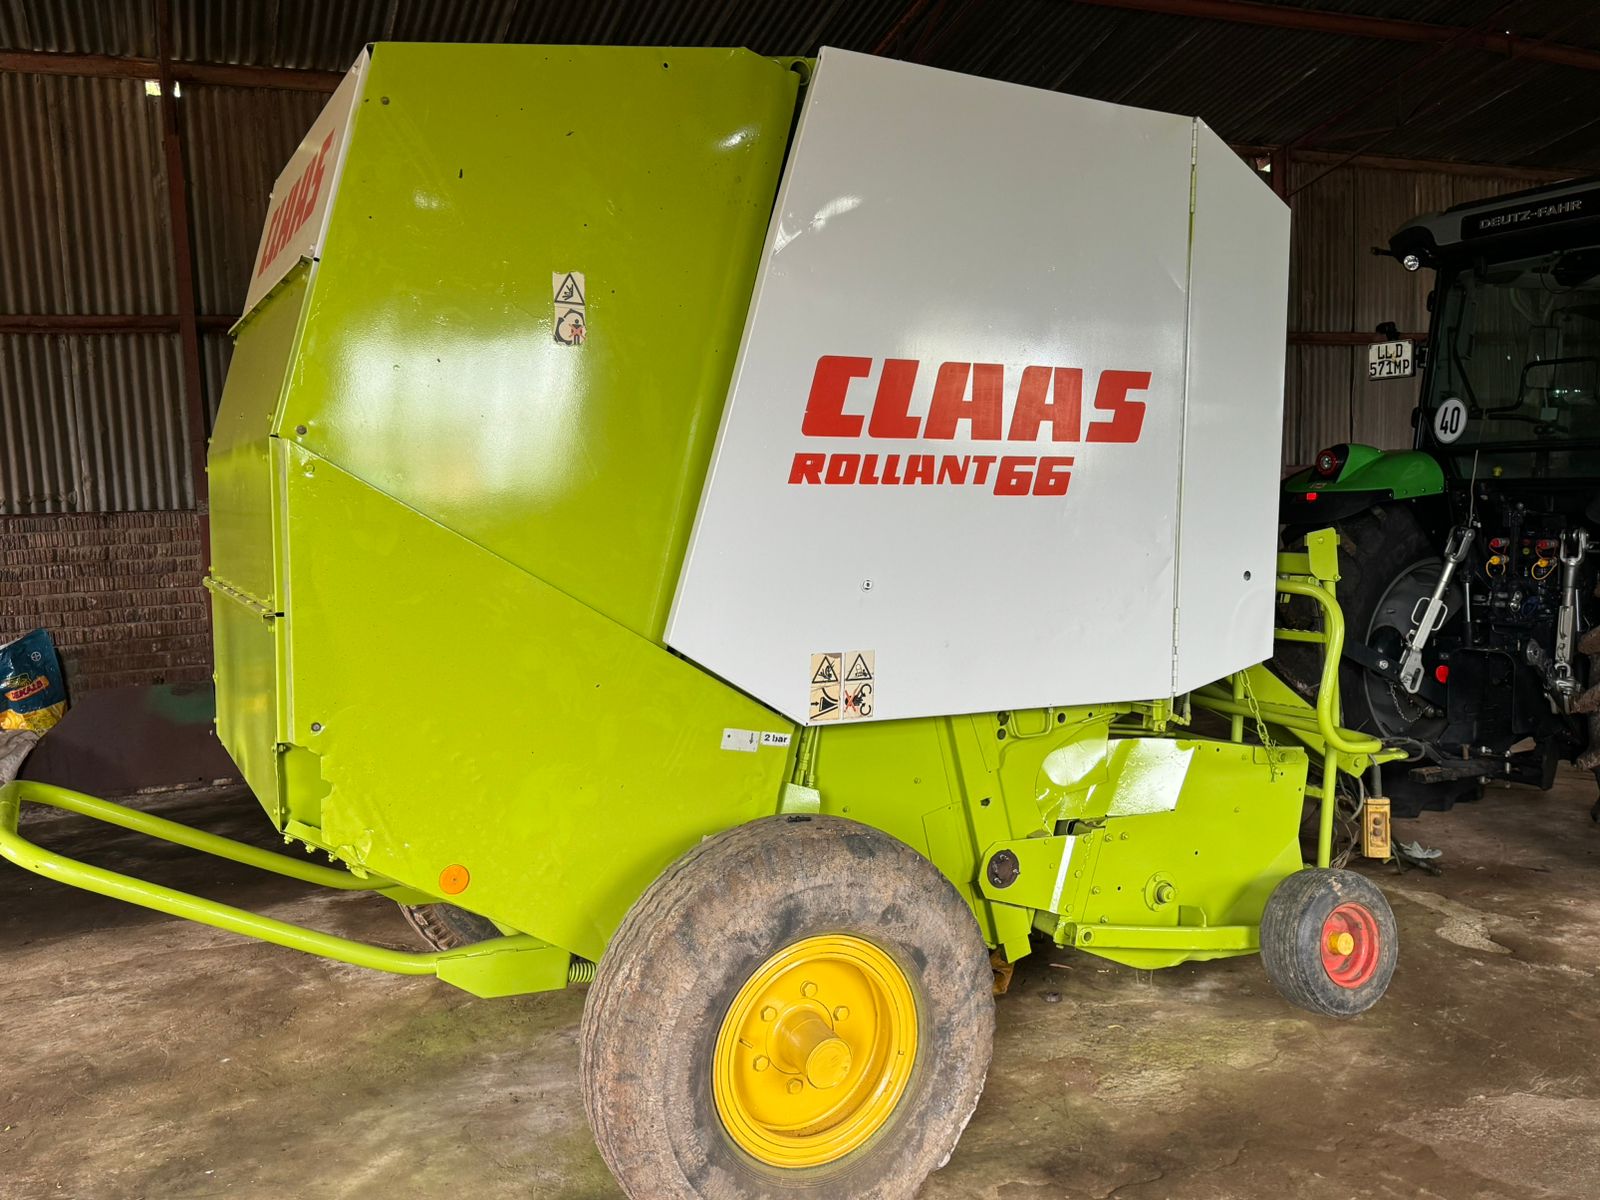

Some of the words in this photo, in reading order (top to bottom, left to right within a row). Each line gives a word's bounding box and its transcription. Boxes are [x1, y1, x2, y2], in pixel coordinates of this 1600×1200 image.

[257, 127, 335, 279] CLAAS
[1479, 199, 1583, 229] DEUTZ-FAHR
[801, 355, 1152, 443] CLAAS
[1439, 406, 1461, 434] 40
[788, 453, 997, 485] ROLLANT
[993, 456, 1075, 496] 66
[764, 733, 771, 742] 2
[772, 734, 788, 743] bar
